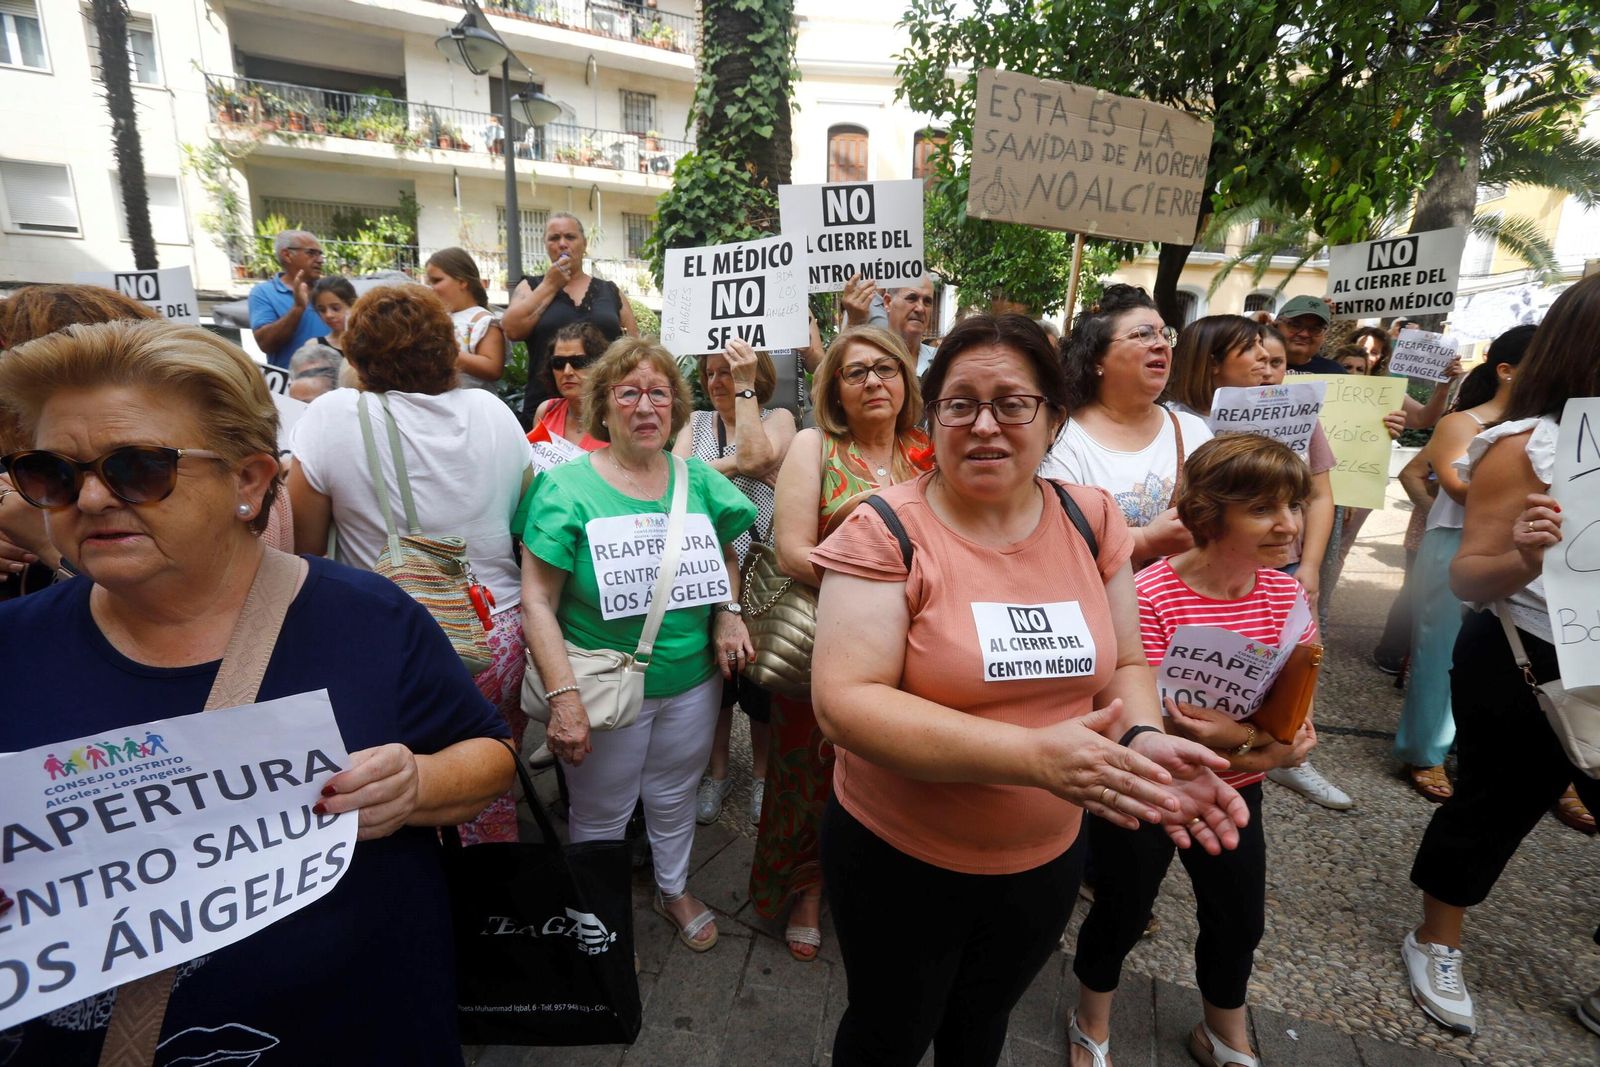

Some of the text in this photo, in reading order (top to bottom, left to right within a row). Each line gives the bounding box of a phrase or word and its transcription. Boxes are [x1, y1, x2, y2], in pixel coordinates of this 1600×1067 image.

[988, 84, 1175, 150] ESTA ES LA
[1101, 142, 1129, 167] DE
[826, 187, 871, 224] NO
[806, 229, 913, 254] L CIERRE DEL
[1370, 239, 1414, 270] NO
[683, 241, 794, 278] EL MÉDICO
[808, 257, 923, 285] NTRO MÉDICO
[117, 274, 157, 300] NO
[1333, 268, 1448, 294] AL CIERRE DEL
[167, 303, 191, 318] DEL
[715, 280, 761, 317] NO
[1389, 291, 1455, 311] MÉDICO
[706, 323, 766, 351] SE VA
[1397, 340, 1456, 358] REAPERTUR
[1394, 352, 1449, 369] CENTRO SALU
[1216, 402, 1320, 422] REAPERTURA
[1273, 423, 1312, 438] SALUD
[594, 534, 717, 561] REAPERURA
[604, 579, 728, 614] LOS ÁGELES
[1010, 609, 1047, 632] NO
[990, 635, 1085, 653] AL CIERRE DEL
[988, 656, 1093, 678] CENTRO MÉDICO
[44, 755, 185, 797] CONSEJO DISTRITO
[45, 787, 101, 809] Alcolea
[112, 777, 138, 790] Los
[140, 765, 193, 783] Angeles
[101, 841, 348, 973] ÁNGELES
